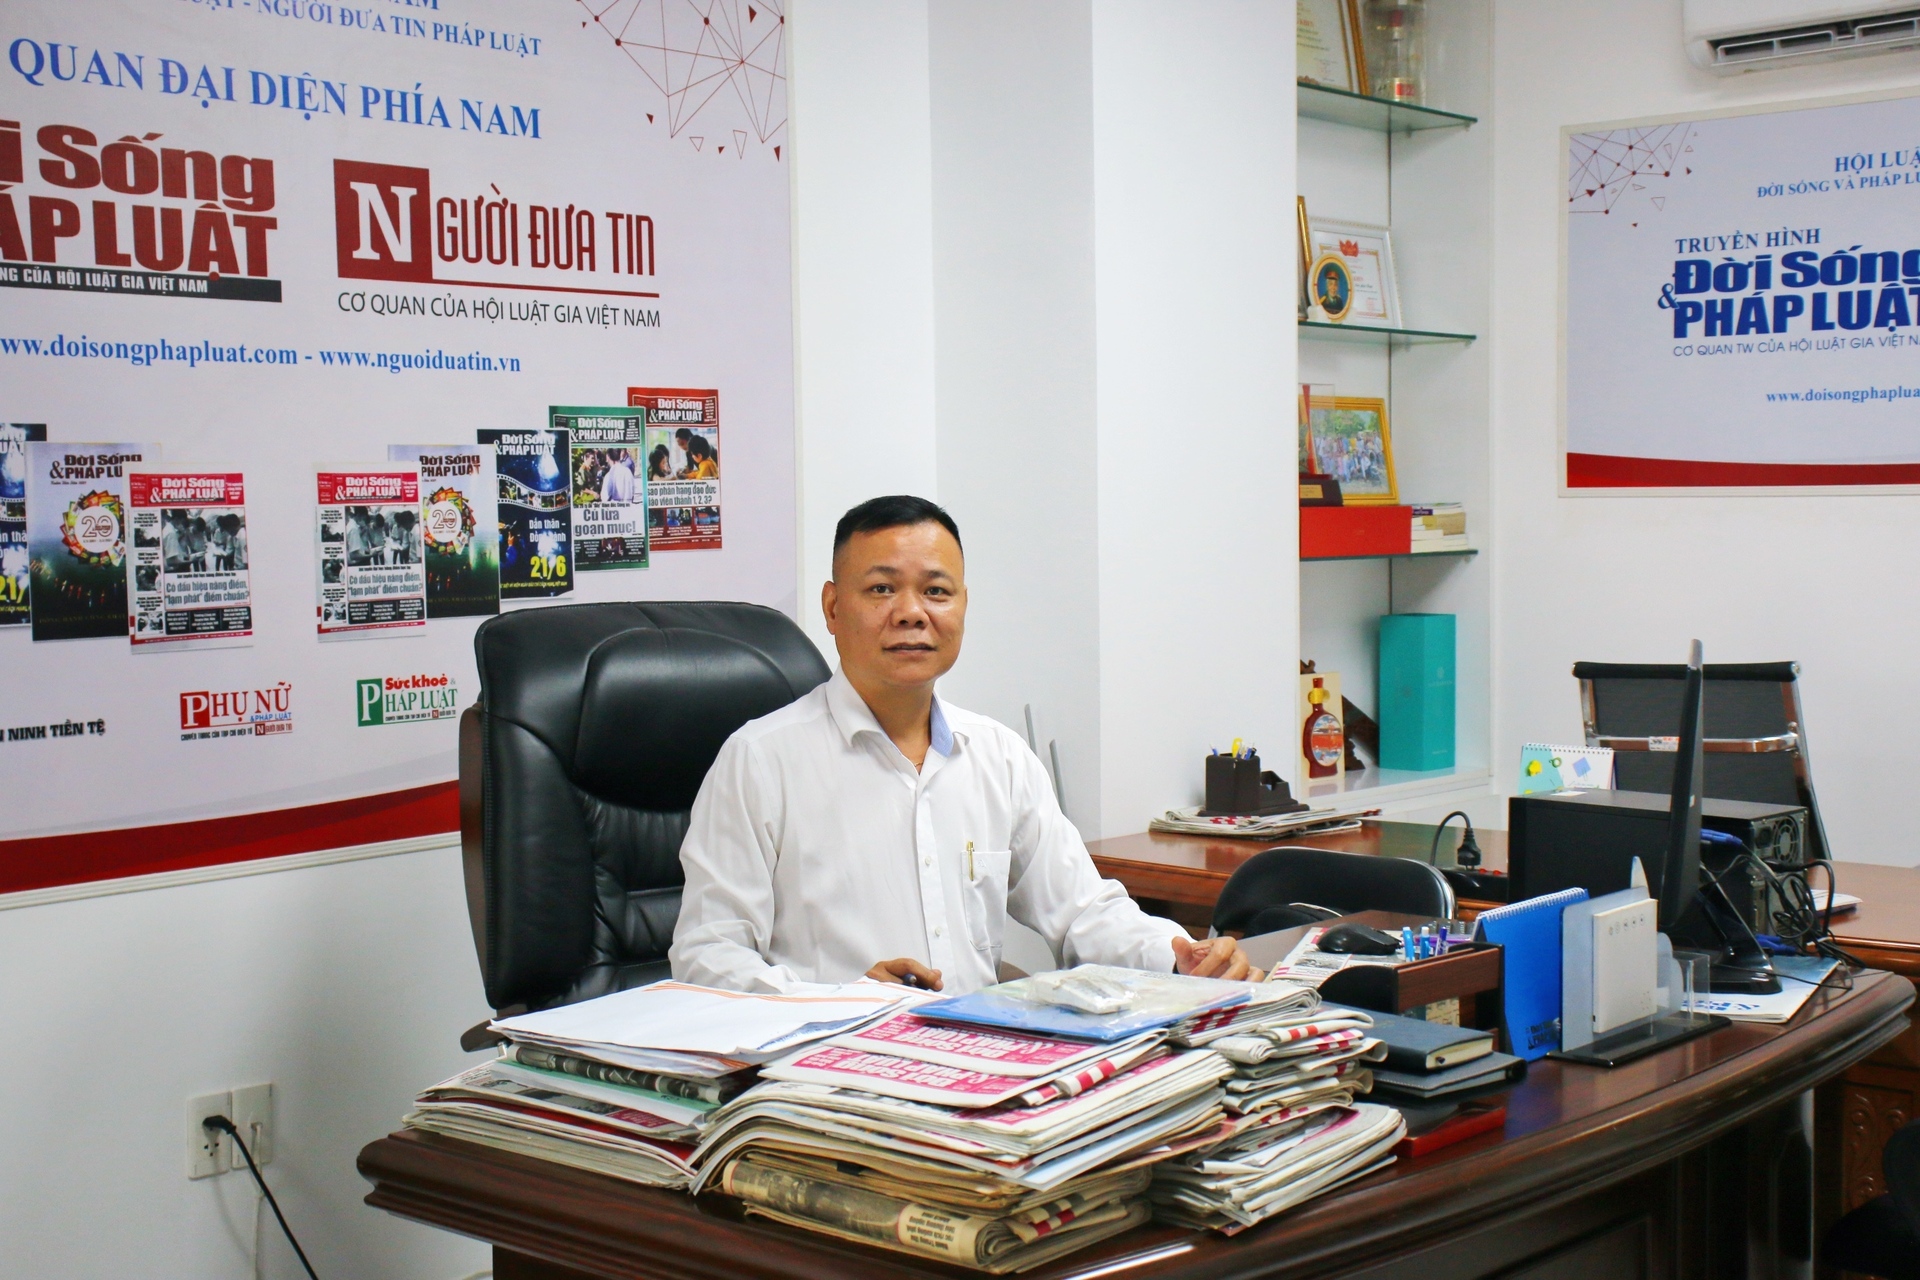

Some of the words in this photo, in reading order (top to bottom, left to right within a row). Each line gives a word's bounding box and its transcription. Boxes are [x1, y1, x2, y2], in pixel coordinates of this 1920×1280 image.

[339, 7, 386, 32] ĐƯA
[390, 15, 426, 38] TIN
[431, 21, 486, 48] PHÁP
[490, 31, 542, 58] LUẬT
[8, 37, 145, 91] QUAN
[158, 58, 239, 109] ĐẠI
[249, 70, 348, 121] DIỆN
[359, 82, 452, 128] PHÍA
[459, 97, 542, 139] NAM
[37, 124, 275, 212] Sống
[1834, 152, 1873, 177] HỘI
[1757, 181, 1785, 198] ĐỜI
[1788, 180, 1830, 197] SỐNG
[1834, 174, 1855, 191] VÀ
[1859, 171, 1902, 188] PHÁP
[92, 199, 278, 281] LUẬT
[528, 203, 596, 272] ĐƯA
[1766, 226, 1821, 248] HÌNH
[23, 266, 52, 283] CỦA
[56, 269, 81, 289] HỘI
[85, 271, 117, 291] LUẬT
[121, 275, 145, 290] GIA
[149, 275, 175, 295] VIỆT
[179, 279, 208, 293] NAM
[1672, 253, 1773, 295] Đời
[337, 291, 367, 314] CƠ
[370, 294, 427, 317] QUAN
[430, 292, 468, 319] CỦA
[473, 299, 505, 325] HỘI
[509, 299, 549, 327] LUẬT
[554, 304, 583, 324] GIA
[587, 304, 619, 329] VIỆT
[624, 308, 661, 328] NAM
[1657, 283, 1680, 310] &
[1673, 291, 1804, 339] PHÁP
[1673, 344, 1694, 357] CƠ
[1697, 344, 1733, 356] QUAN
[1736, 344, 1754, 354] TW
[1757, 337, 1785, 354] CỦA
[1789, 336, 1812, 354] HỘI
[1816, 335, 1846, 352] LUẬT
[1850, 337, 1875, 349] GIA
[1879, 333, 1905, 348] VIỆT
[319, 349, 522, 374] www.nguoiduatin.vn
[254, 681, 292, 714] NỮ
[385, 677, 410, 691] Sức
[421, 687, 458, 710] LUẬT
[8, 725, 46, 741] NINH
[50, 718, 84, 738] TIỀN
